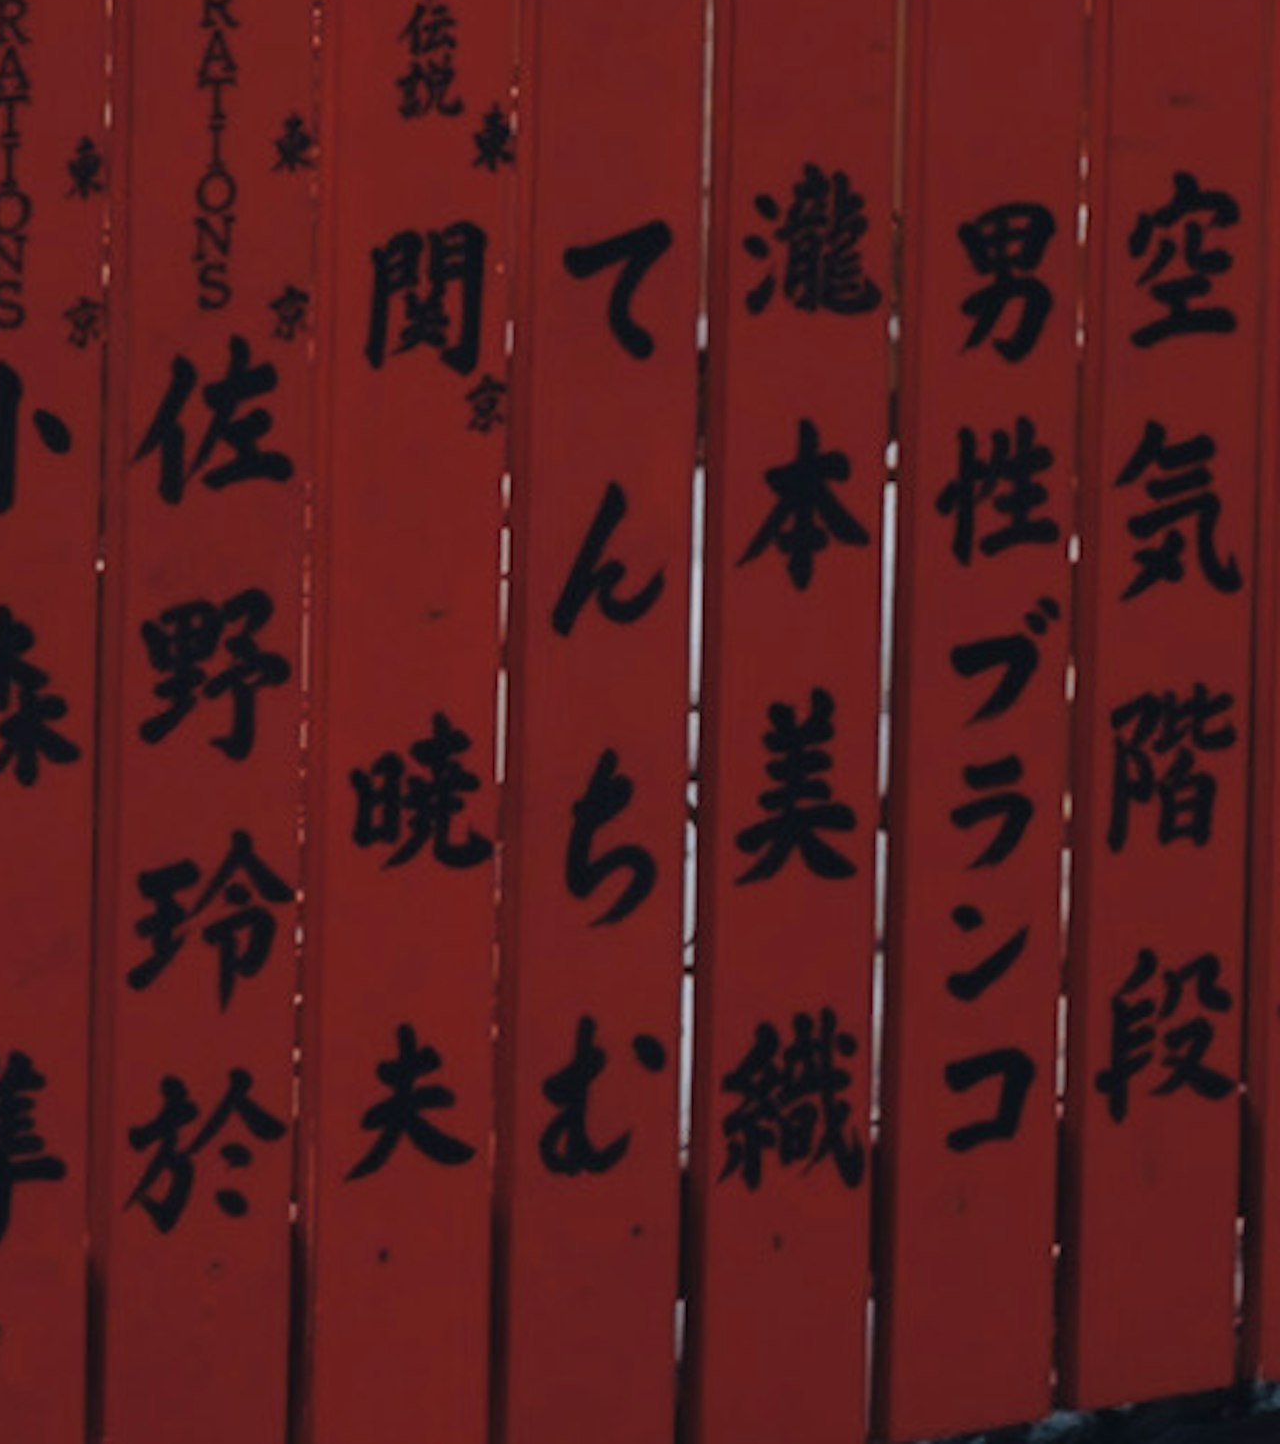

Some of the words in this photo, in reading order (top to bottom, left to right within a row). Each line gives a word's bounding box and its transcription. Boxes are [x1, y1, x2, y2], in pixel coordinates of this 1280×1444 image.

[123, 333, 295, 1234] 佐野玲於
[342, 219, 495, 1183] 関暁夫
[539, 219, 673, 1176] てんちむ
[717, 162, 883, 1191] 瀧本美織
[934, 203, 1061, 1153] 男性ブランコ
[1095, 170, 1245, 1124] 空気階段
